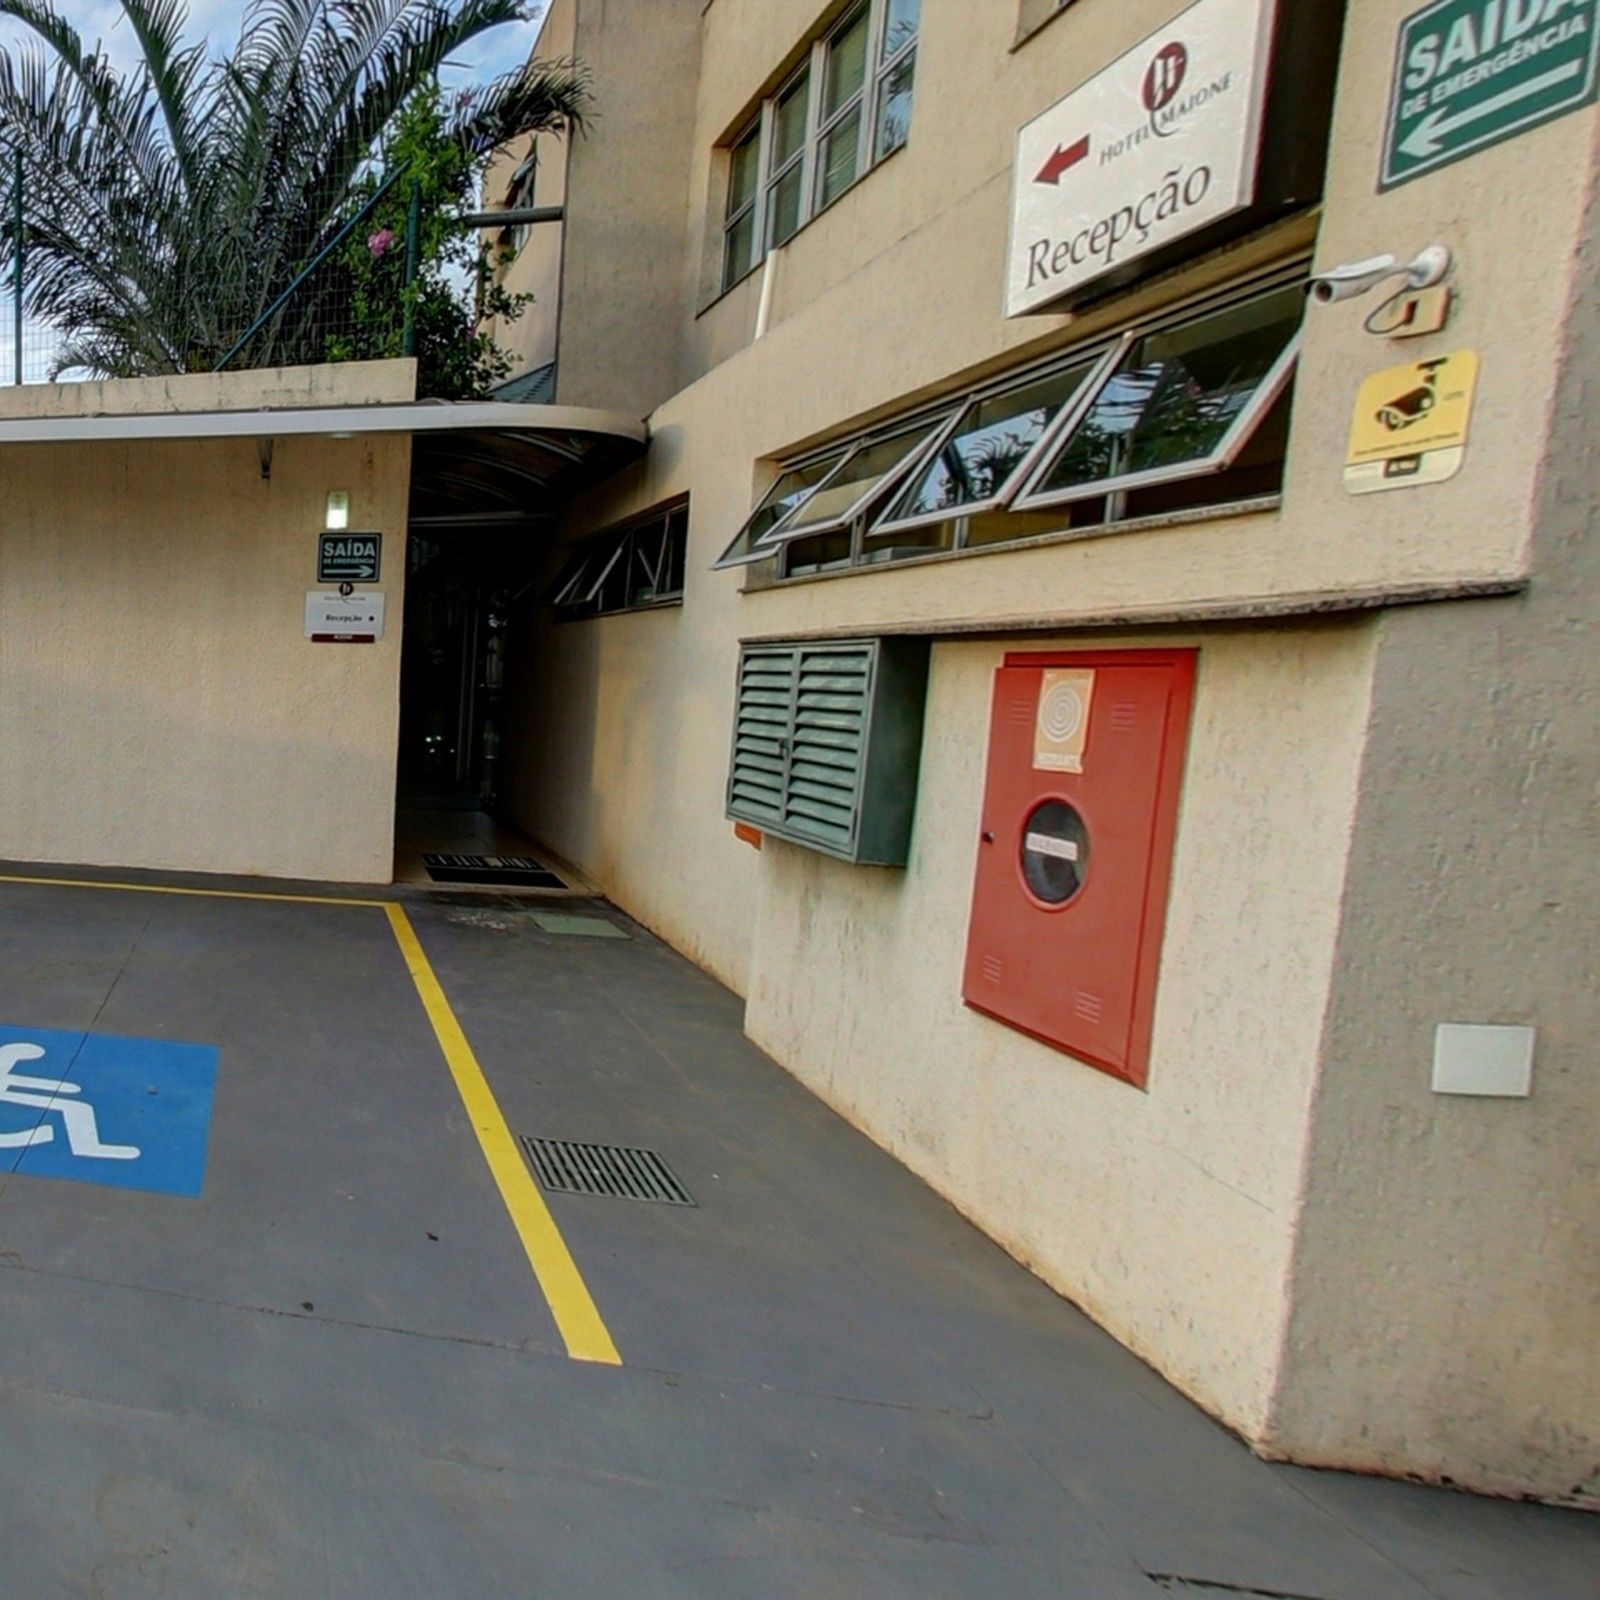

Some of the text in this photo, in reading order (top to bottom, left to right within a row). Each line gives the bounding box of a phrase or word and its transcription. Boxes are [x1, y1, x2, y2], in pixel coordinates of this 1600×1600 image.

[1401, 13, 1587, 120] DE EMERGÊNCIA
[1100, 71, 1233, 167] HOTEL MAIONE
[1025, 164, 1211, 290] Recepção
[324, 539, 376, 556] SAÍDA
[326, 614, 362, 622] Recepção
